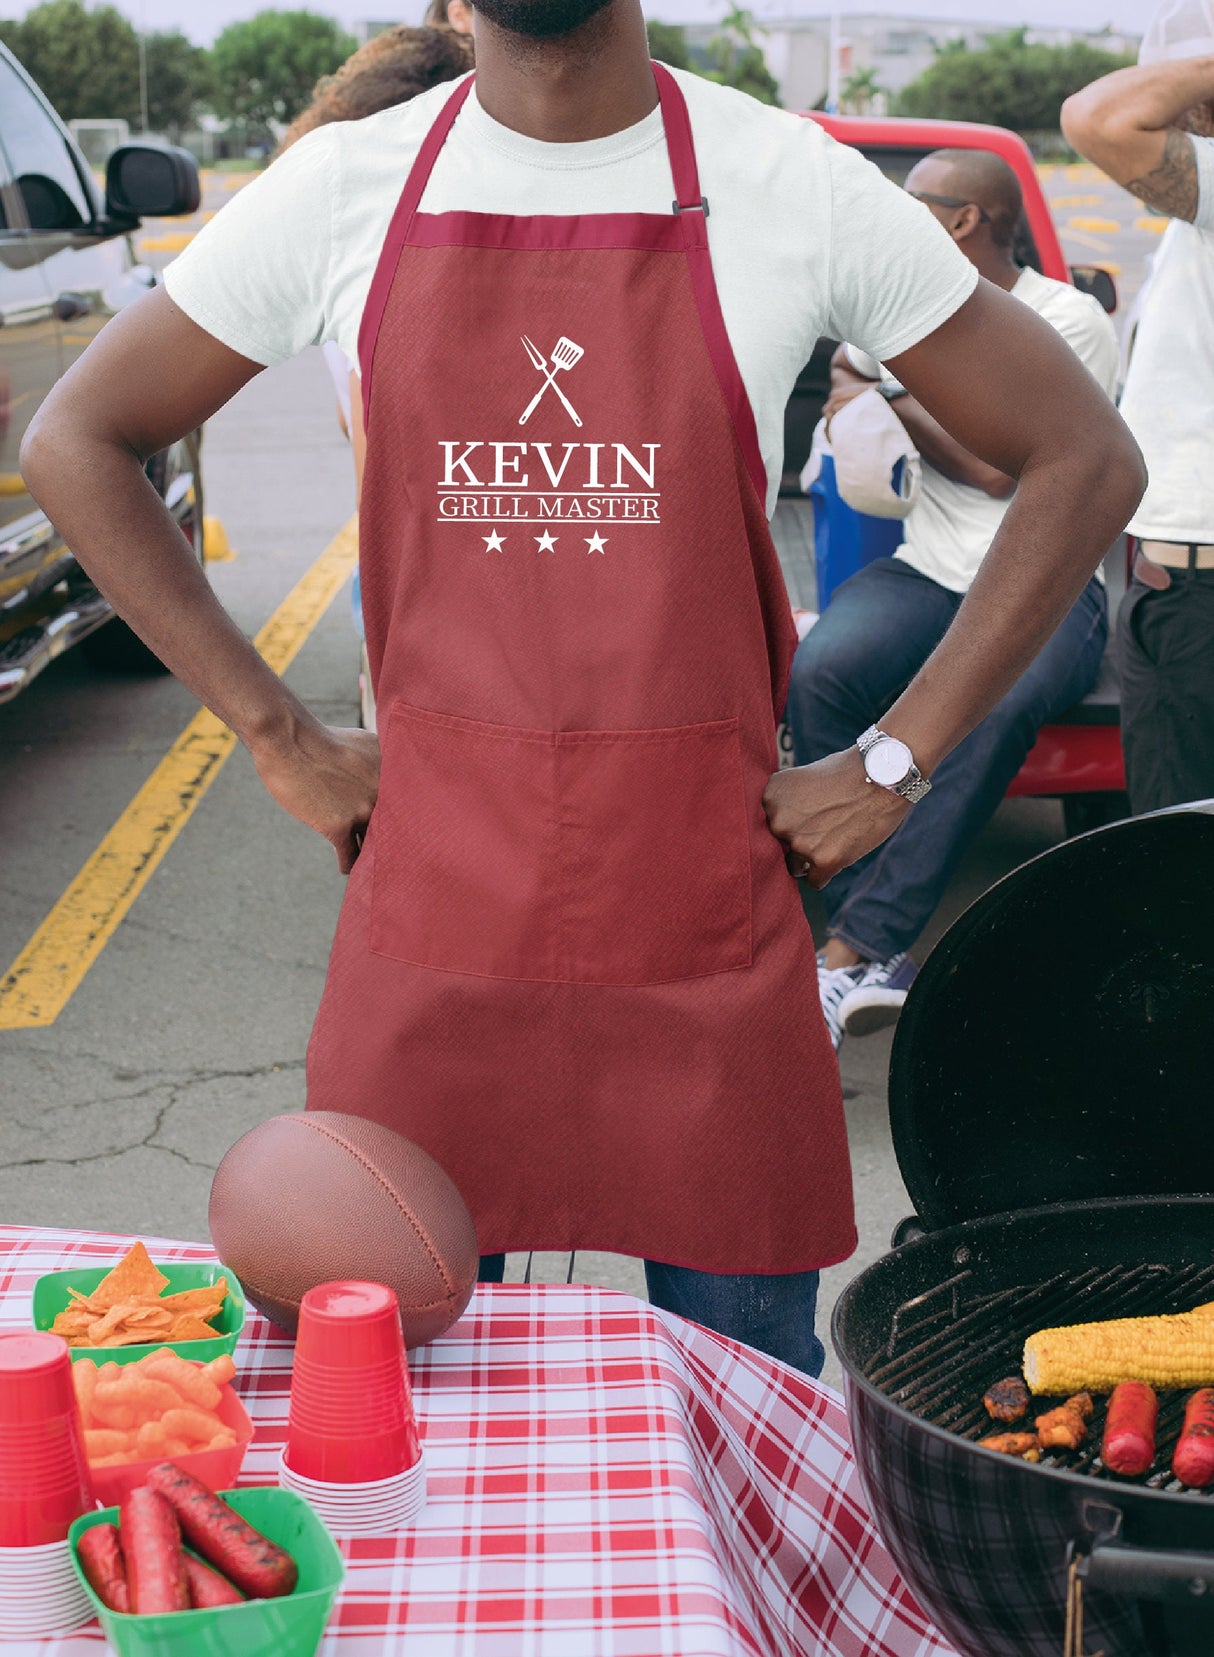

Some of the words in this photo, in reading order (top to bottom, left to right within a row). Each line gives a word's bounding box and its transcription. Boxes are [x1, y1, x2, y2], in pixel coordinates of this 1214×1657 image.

[437, 441, 662, 489] KEVIN
[439, 496, 529, 517] GRILL
[536, 497, 661, 519] MASTER
